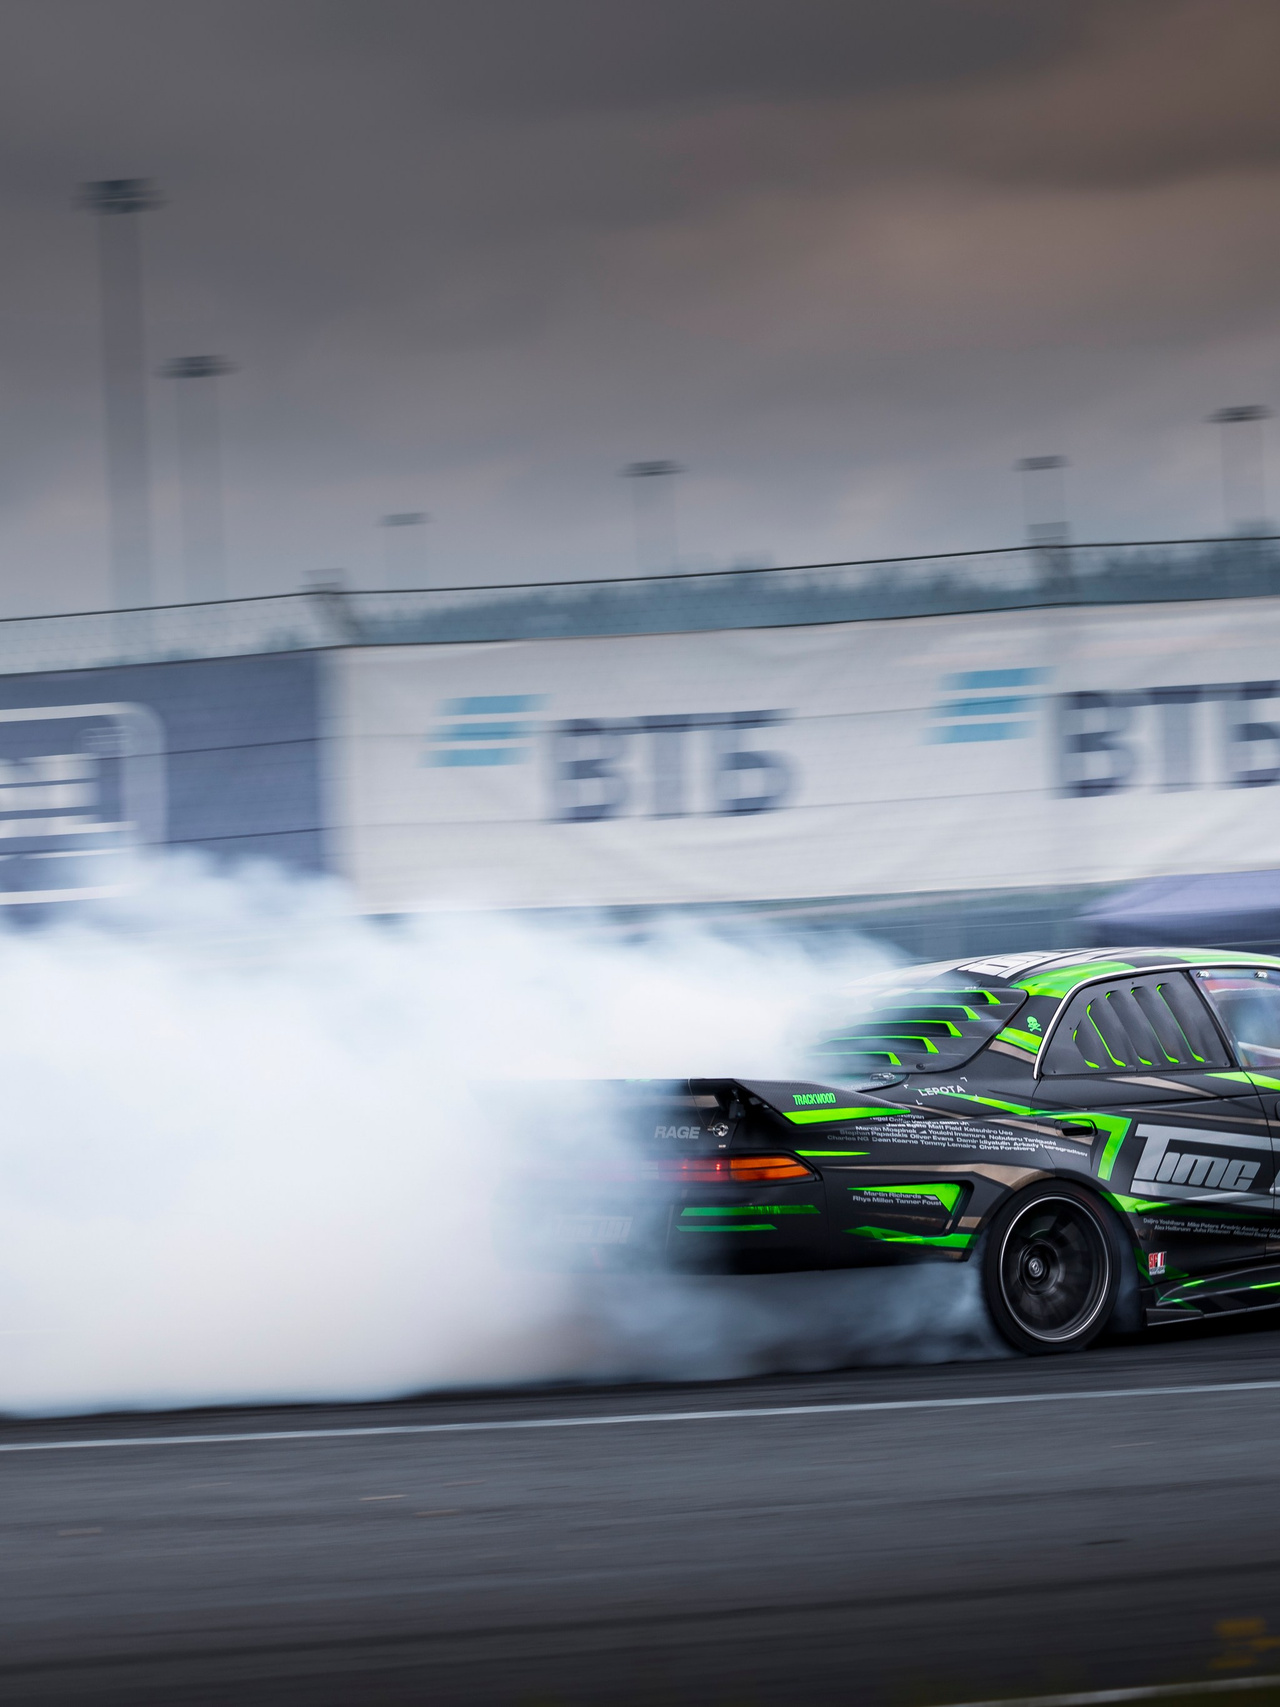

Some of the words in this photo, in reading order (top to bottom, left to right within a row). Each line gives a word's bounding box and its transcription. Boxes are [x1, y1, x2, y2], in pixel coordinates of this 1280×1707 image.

[545, 708, 800, 823] ВТБ
[917, 1084, 966, 1097] LEPOTA
[792, 1092, 837, 1106] TRACKWOOD
[653, 1125, 701, 1140] RAGE
[852, 1195, 871, 1203] Rhys
[895, 1197, 921, 1205] Tanner
[863, 1190, 888, 1198] Martin
